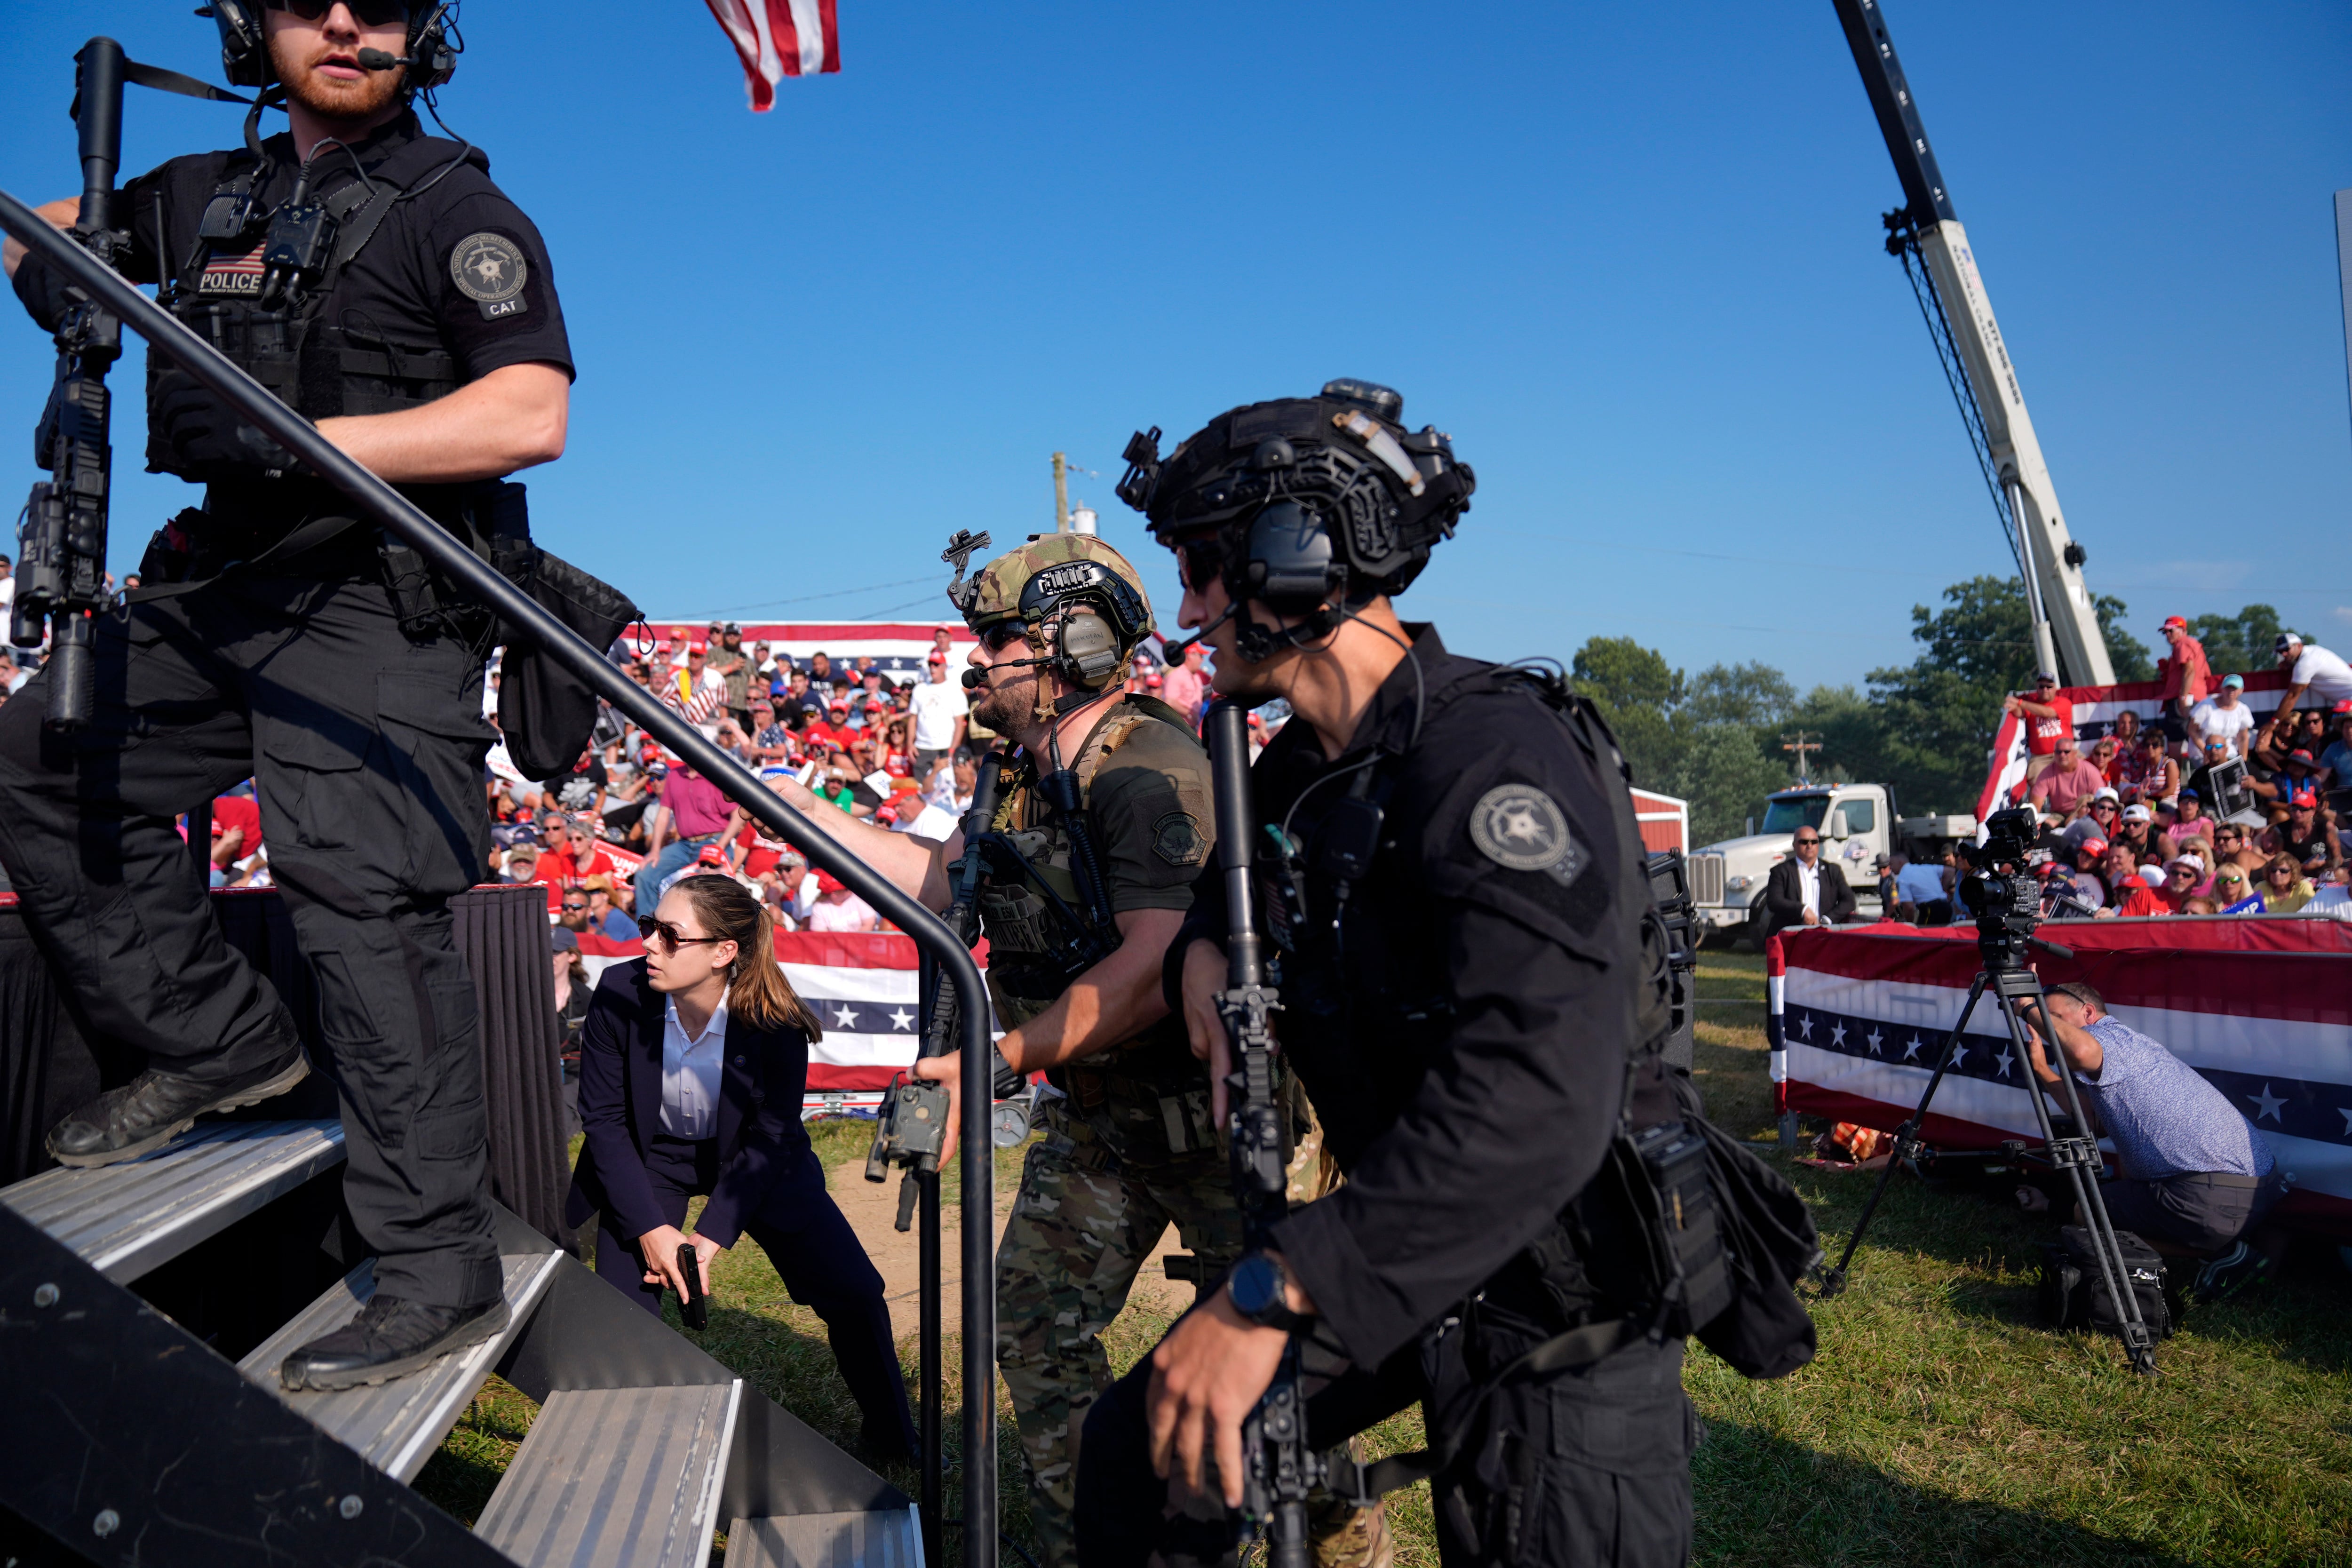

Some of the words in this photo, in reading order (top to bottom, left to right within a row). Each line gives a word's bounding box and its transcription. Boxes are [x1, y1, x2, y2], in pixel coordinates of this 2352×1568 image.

[199, 272, 262, 289] POLICE
[1953, 244, 1976, 304] NATIONAL
[489, 300, 516, 315] CAT
[1001, 906, 1016, 919] ESU
[986, 923, 1034, 949] POLICE
[1065, 961, 1084, 973] MOTOROLA
